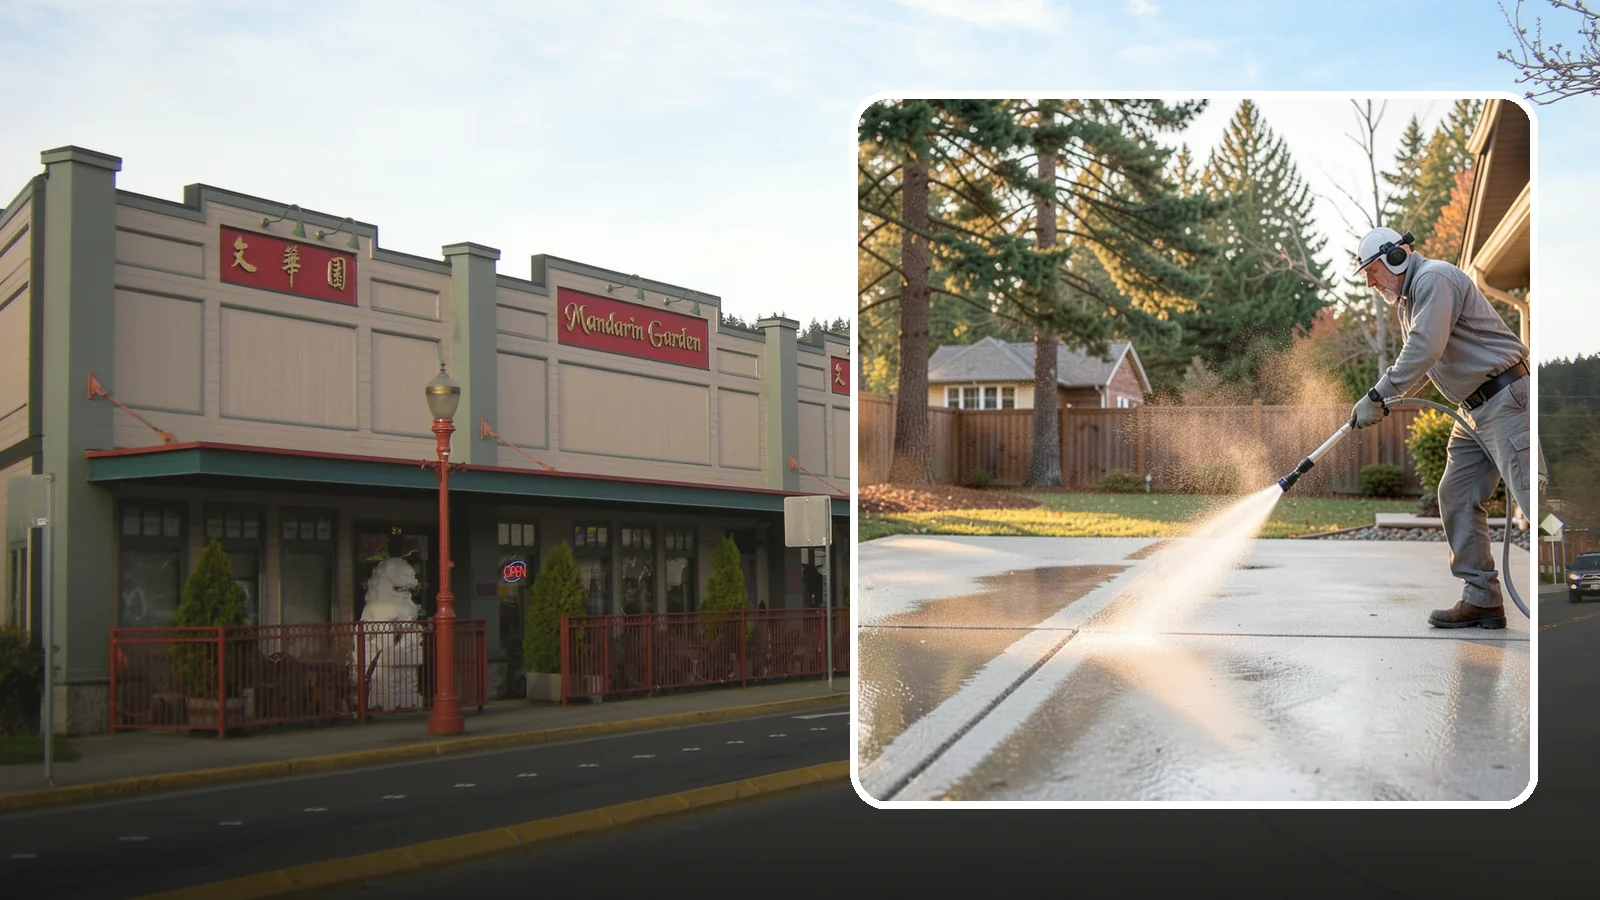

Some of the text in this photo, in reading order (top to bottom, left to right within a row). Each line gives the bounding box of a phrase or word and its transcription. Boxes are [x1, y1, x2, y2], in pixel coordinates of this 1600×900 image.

[230, 235, 347, 291] 文華園
[564, 302, 701, 352] Mandarin Garden
[835, 363, 847, 386] 文
[503, 565, 527, 578] OPEN
